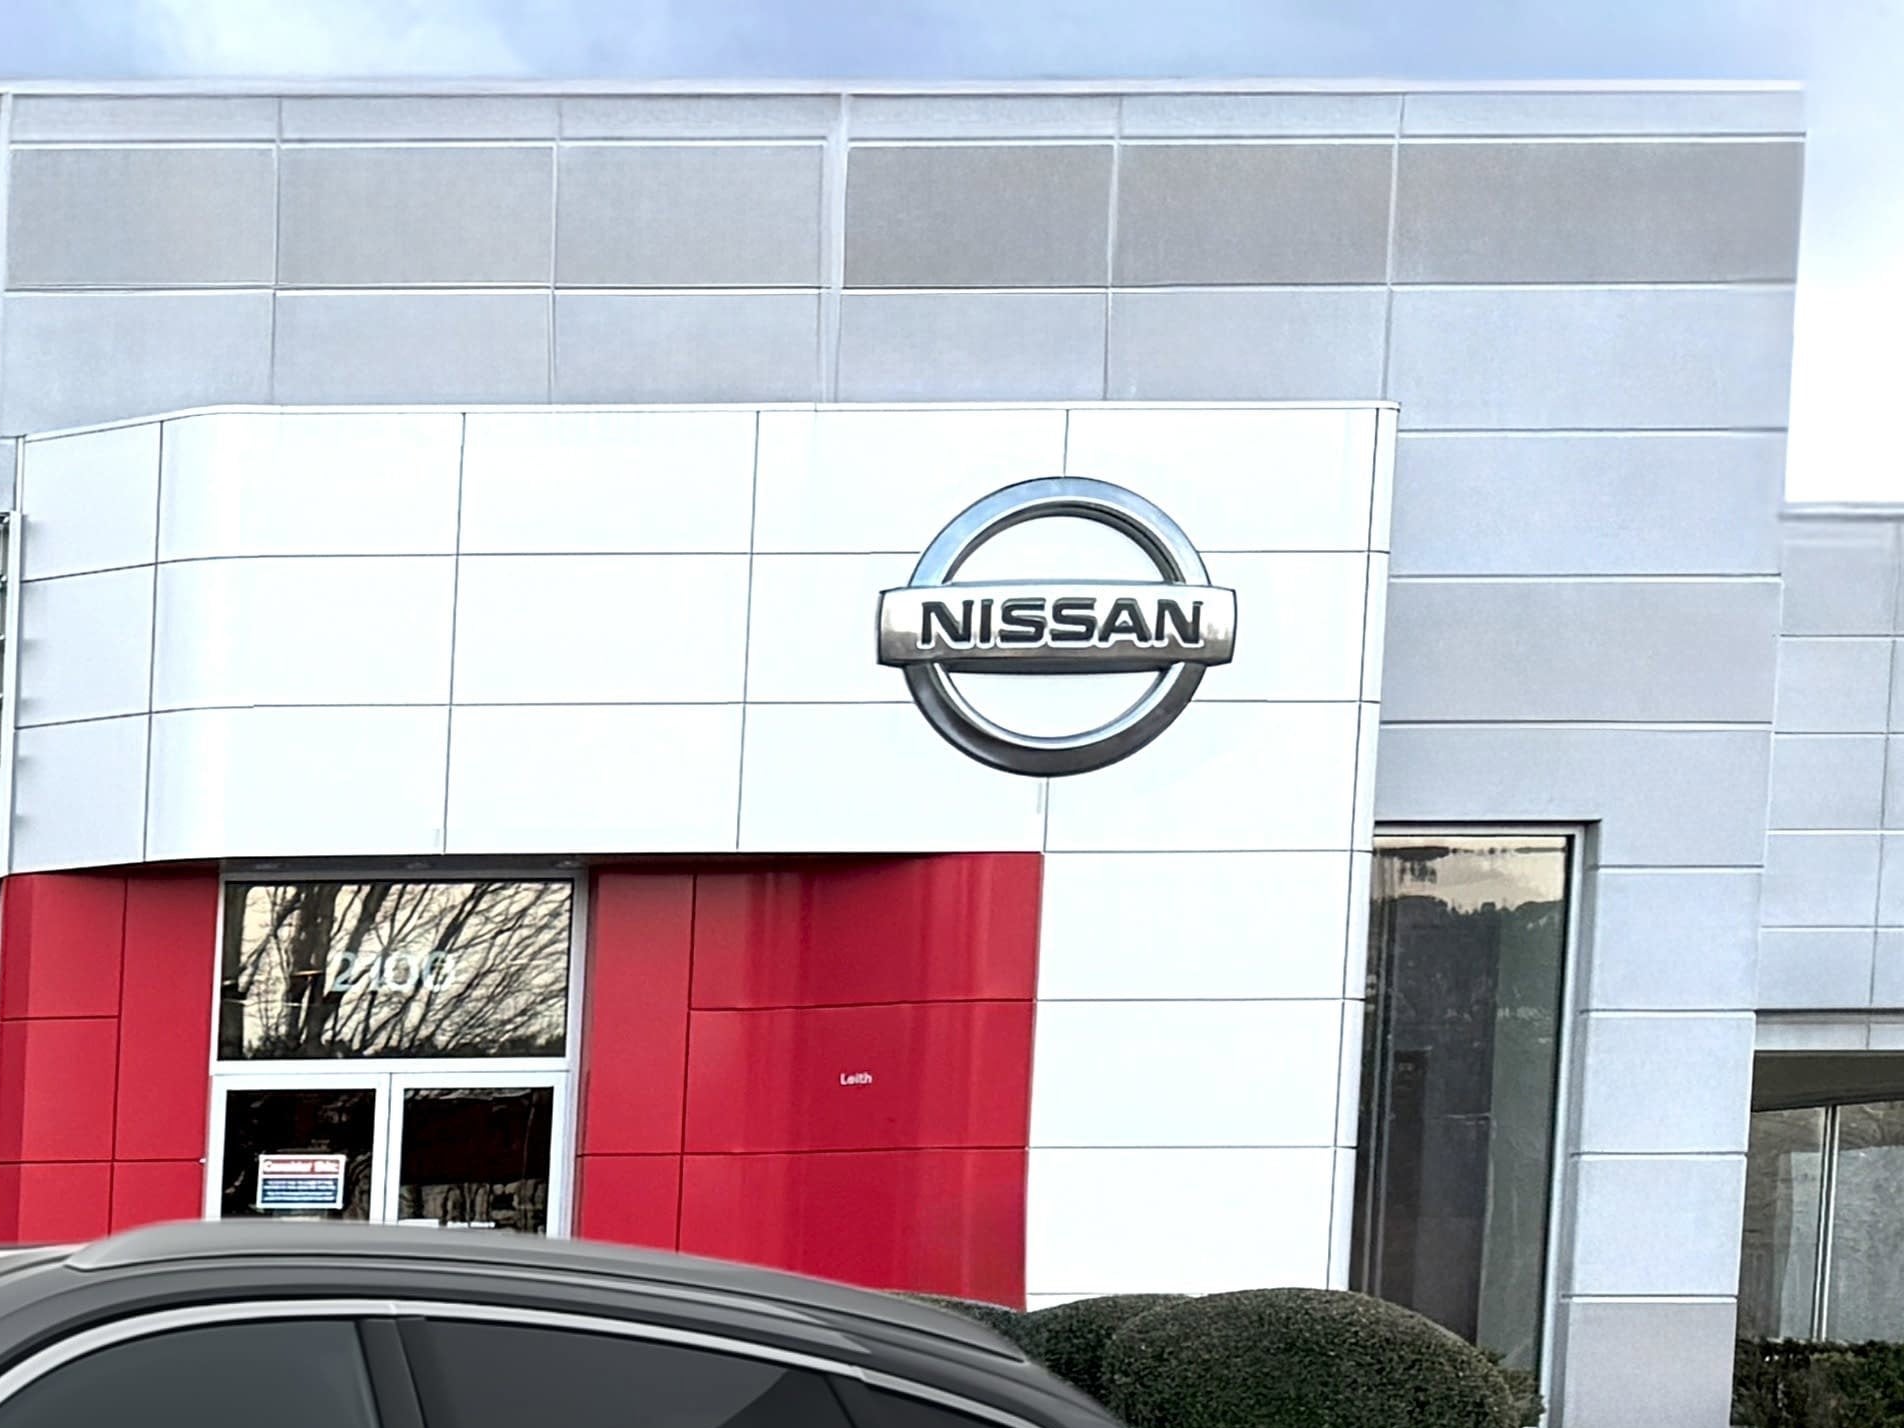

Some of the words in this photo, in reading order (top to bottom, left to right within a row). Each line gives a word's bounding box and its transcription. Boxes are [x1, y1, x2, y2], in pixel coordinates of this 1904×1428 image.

[917, 597, 1206, 648] NISSAN
[331, 951, 456, 992] 2100
[840, 1072, 873, 1086] Leith
